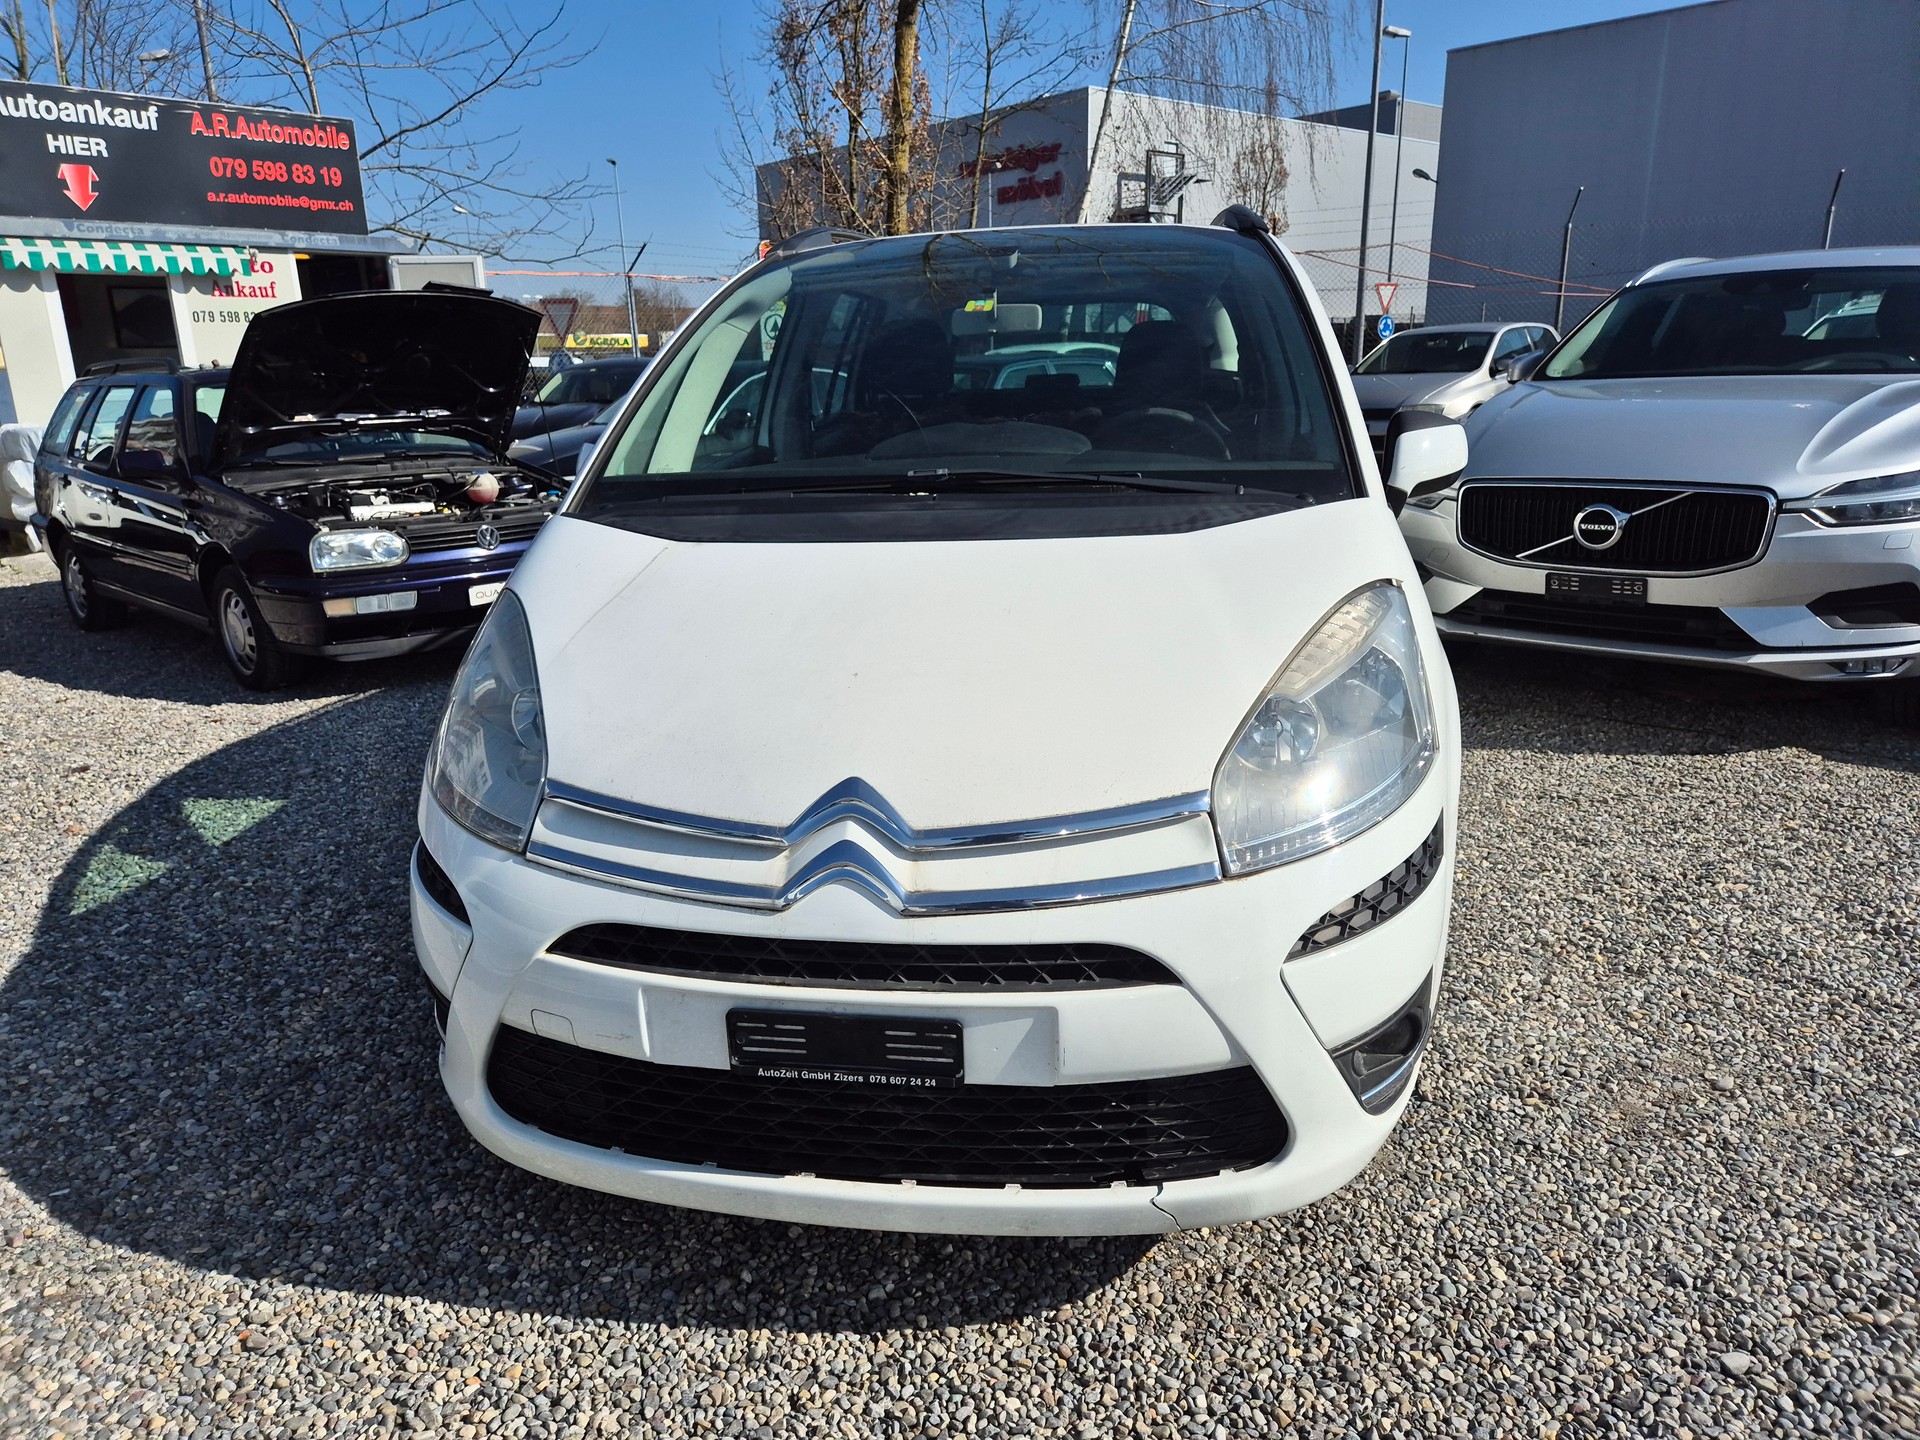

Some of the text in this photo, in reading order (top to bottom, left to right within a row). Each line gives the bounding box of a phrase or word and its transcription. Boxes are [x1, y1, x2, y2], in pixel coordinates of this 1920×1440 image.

[46, 133, 109, 158] HIER
[209, 156, 342, 187] 079 598 83 19
[207, 191, 354, 211] a.r.automobile@gmx.ch
[76, 223, 145, 235] Condecta
[211, 280, 278, 298] Ankauf
[192, 310, 215, 323] 079
[219, 311, 241, 323] 598
[590, 337, 630, 346] AGROLA
[1580, 523, 1615, 531] VOLVO
[475, 588, 500, 599] QUA
[757, 1067, 936, 1087] AutoZeit GmbH Zizers 078 607 24 24
